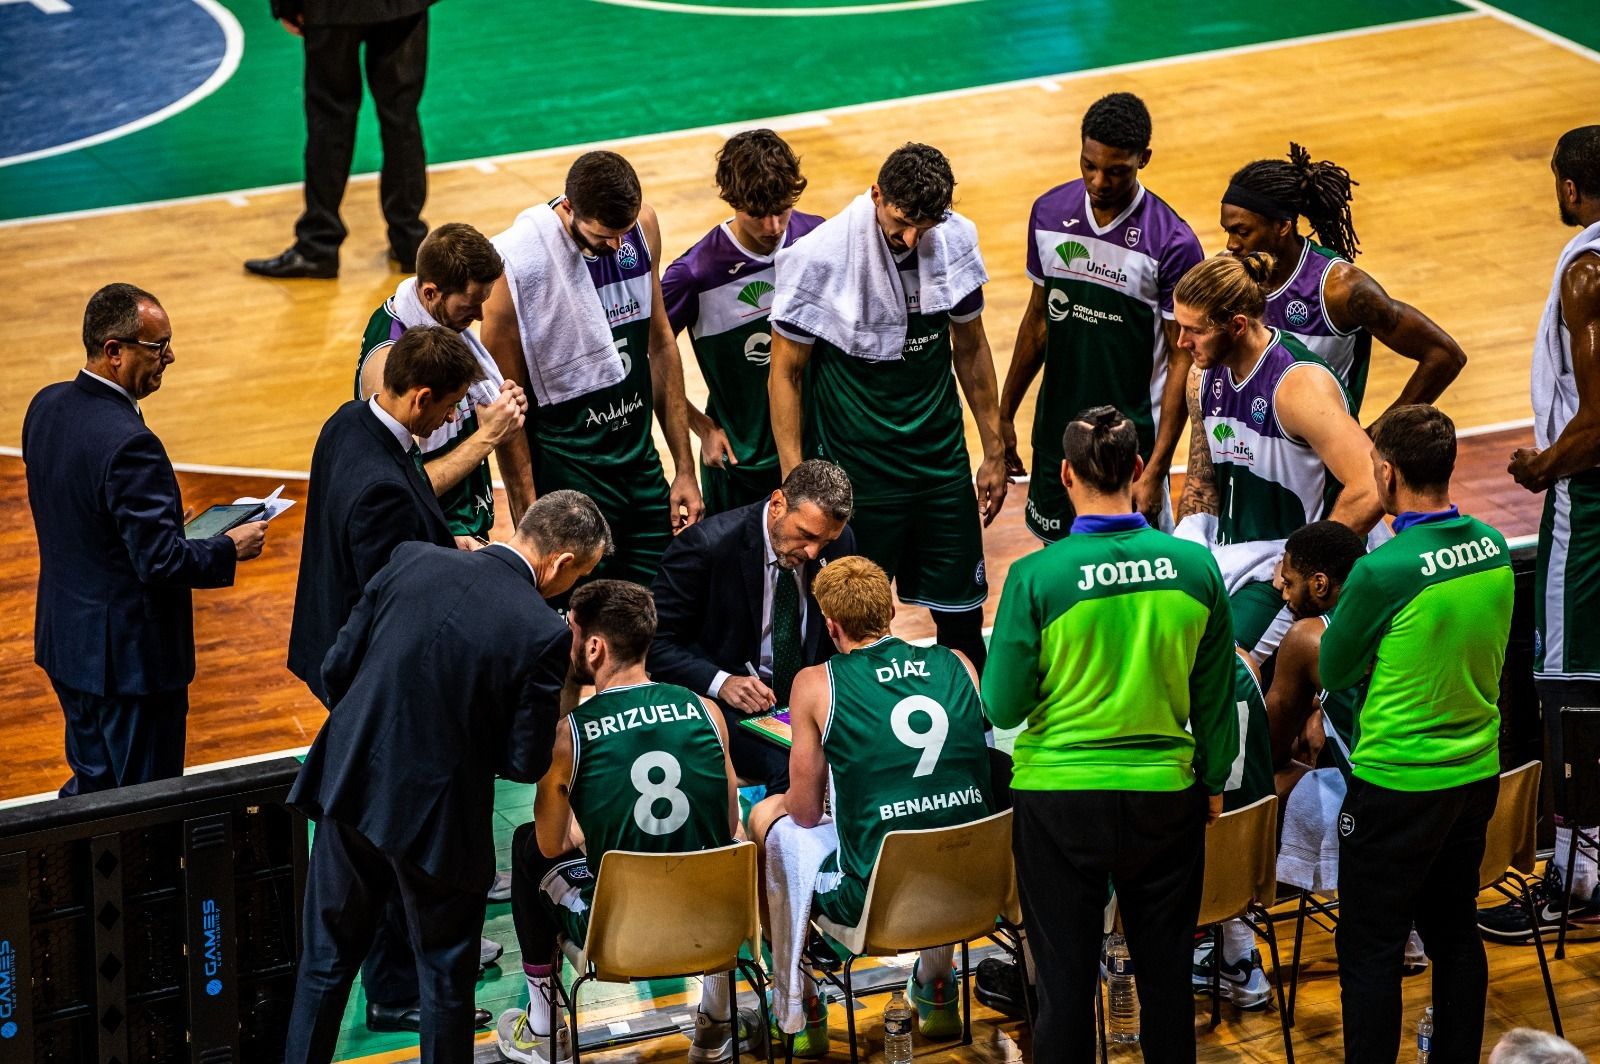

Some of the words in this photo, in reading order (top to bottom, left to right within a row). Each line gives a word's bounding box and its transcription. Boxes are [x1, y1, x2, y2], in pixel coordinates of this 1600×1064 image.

[1086, 260, 1128, 283] Unicaja
[1093, 310, 1108, 320] DEL
[1108, 314, 1124, 323] SOL
[875, 658, 931, 683] DÍAZ
[583, 702, 702, 741] BRIZUELA
[890, 694, 950, 778] 9
[630, 750, 690, 836] 8
[879, 786, 984, 821] BENAHAVÍS
[203, 899, 217, 976] GAMES
